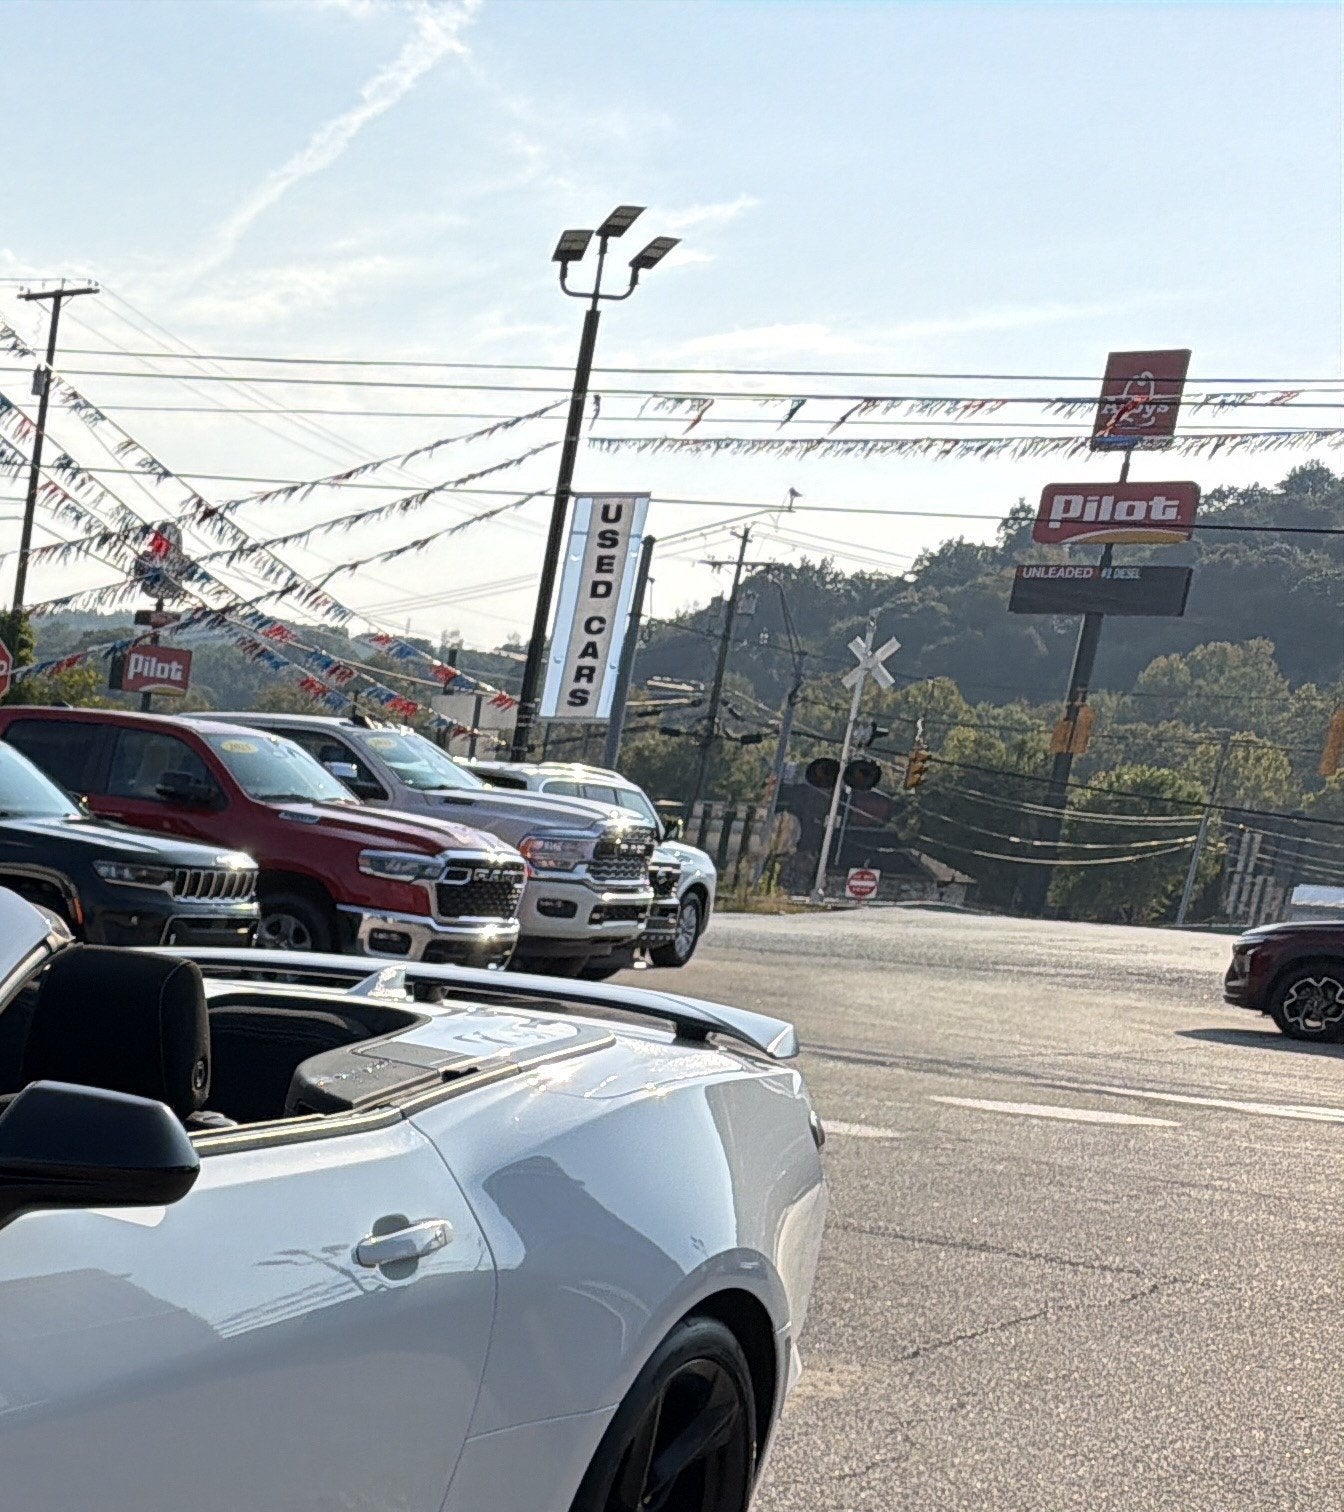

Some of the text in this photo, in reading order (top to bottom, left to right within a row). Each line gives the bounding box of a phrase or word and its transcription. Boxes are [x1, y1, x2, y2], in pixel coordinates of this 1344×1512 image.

[1048, 494, 1180, 529] Pilot
[1022, 567, 1093, 579] UNLEADED
[566, 503, 623, 708] USED CARS
[127, 652, 183, 681] Pilot
